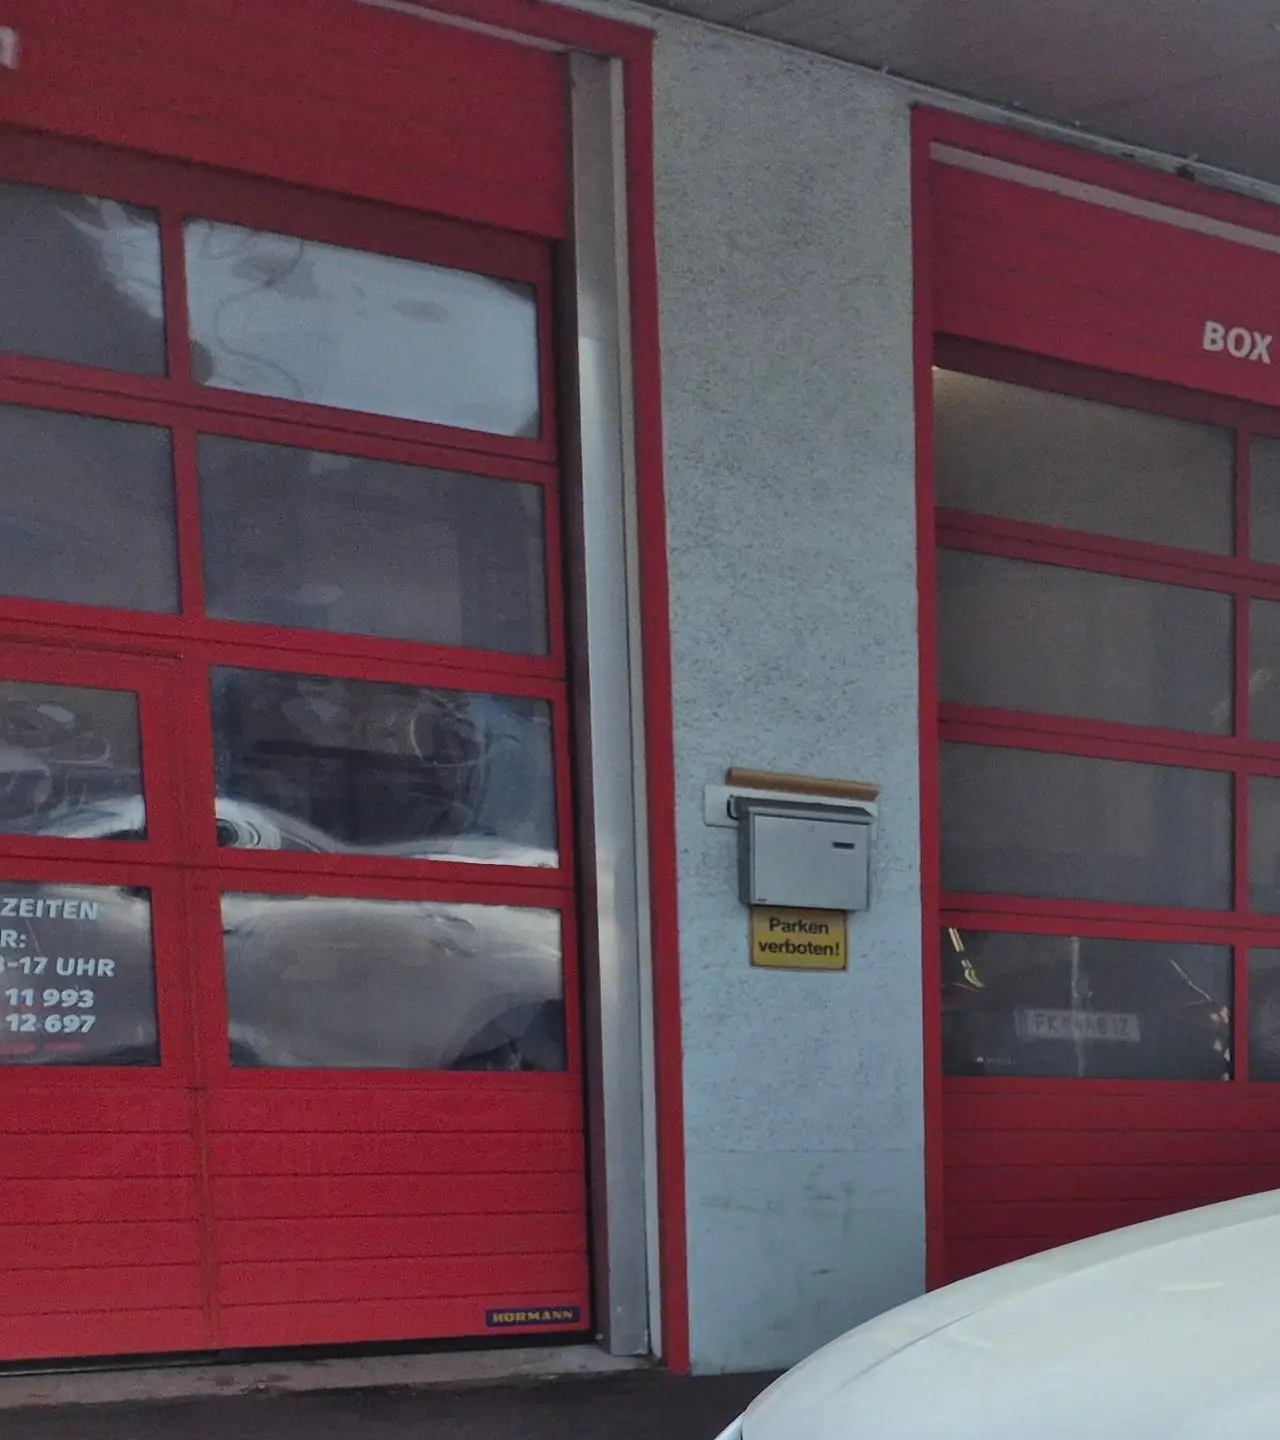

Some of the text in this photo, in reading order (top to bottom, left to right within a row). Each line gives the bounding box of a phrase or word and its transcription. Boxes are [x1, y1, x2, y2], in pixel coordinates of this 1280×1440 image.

[1203, 320, 1273, 365] BOX
[1, 897, 98, 921] ZEITEN
[768, 916, 829, 935] Parken
[758, 938, 841, 957] verboten!
[0, 955, 116, 978] -17 UHR
[4, 988, 95, 1009] 11 993
[5, 1013, 97, 1034] 12 697
